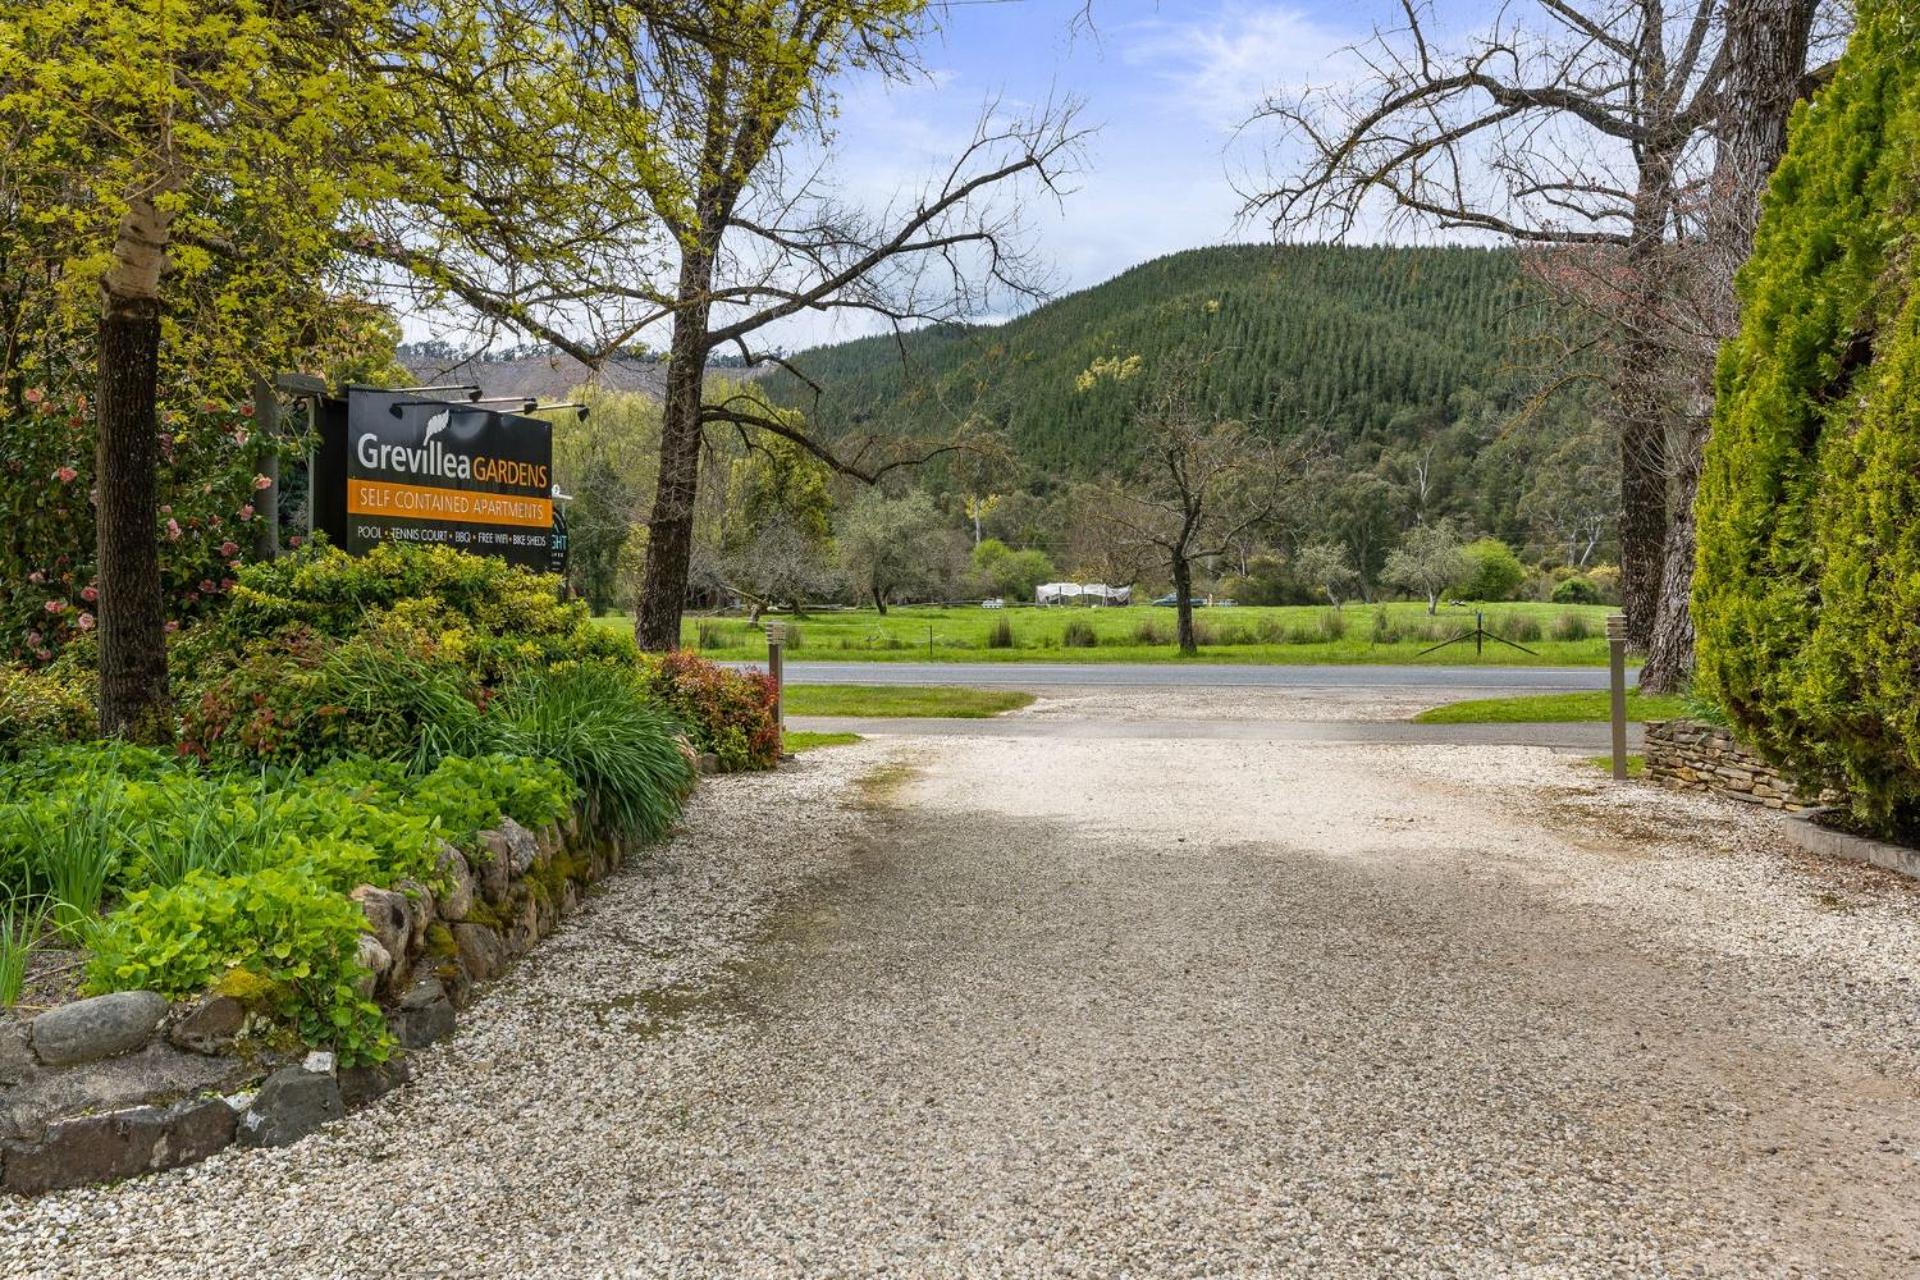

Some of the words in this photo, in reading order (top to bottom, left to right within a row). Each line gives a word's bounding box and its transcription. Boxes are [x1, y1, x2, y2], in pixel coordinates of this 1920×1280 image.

[357, 432, 471, 480] Grevillea
[473, 456, 548, 488] GARDENS
[360, 487, 390, 507] SELF
[394, 491, 469, 513] CONTAINED
[473, 498, 544, 520] APARTMENTS
[357, 525, 382, 539] POOL
[391, 527, 420, 541] TENNIS
[421, 529, 448, 542] COURT
[455, 531, 471, 543] BBQ
[478, 532, 493, 544] FREE
[512, 534, 526, 545] BIKE
[526, 535, 546, 547] SHEDS
